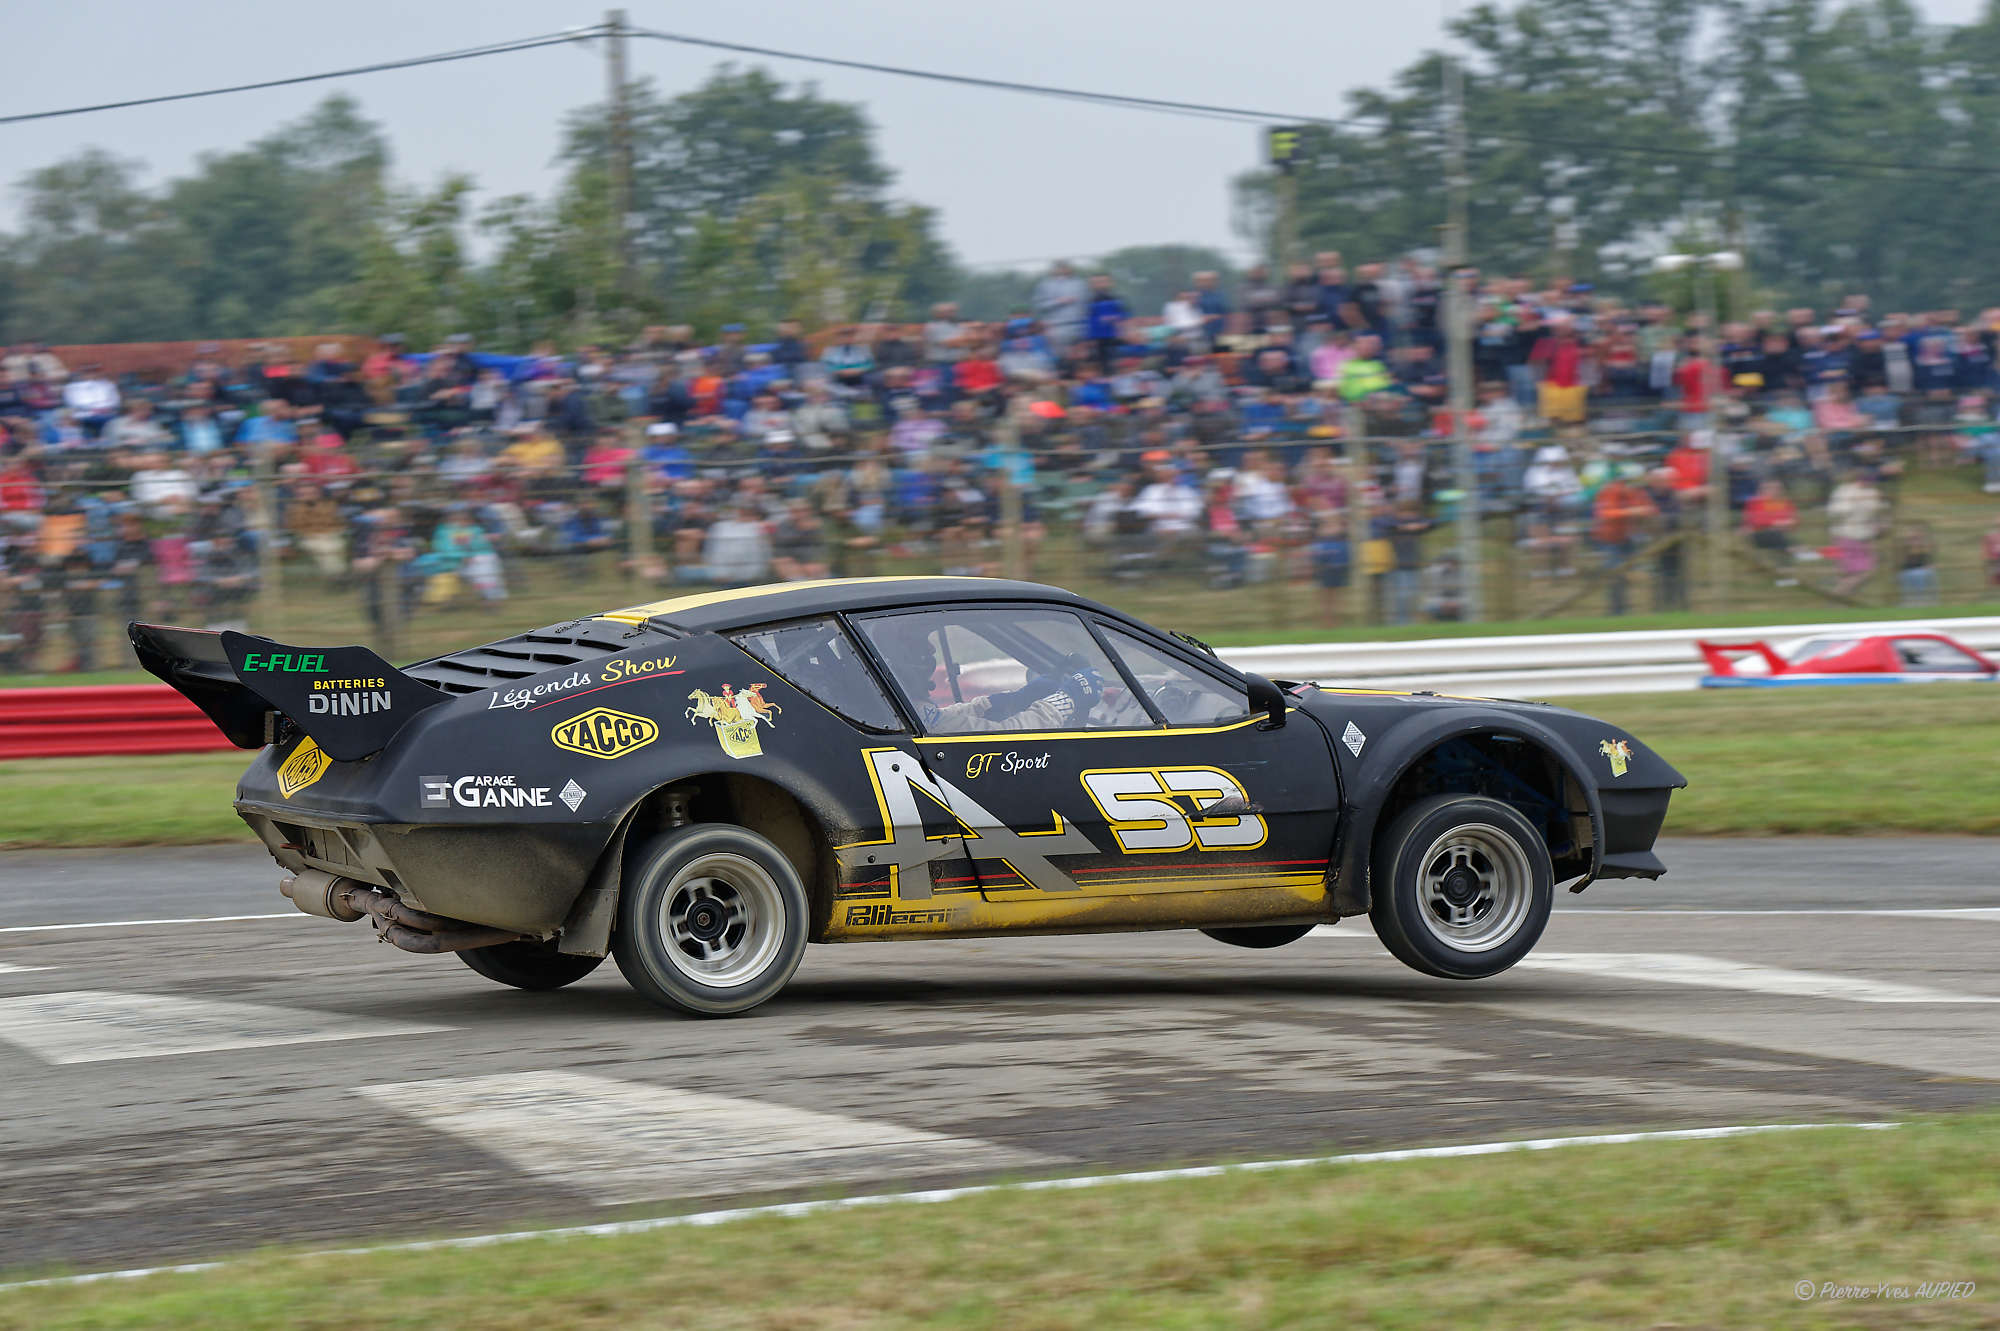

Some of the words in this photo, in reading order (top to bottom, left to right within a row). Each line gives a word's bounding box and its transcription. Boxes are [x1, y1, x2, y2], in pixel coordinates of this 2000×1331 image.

[243, 653, 329, 673] E-FUEL
[313, 677, 386, 690] BATTERIES
[487, 671, 592, 710] Légends
[600, 655, 677, 682] Show
[562, 714, 644, 752] YACCO
[965, 752, 1002, 779] GT
[1000, 750, 1051, 775] Sport
[1079, 765, 1269, 855] 53
[845, 904, 968, 926] Politecni
